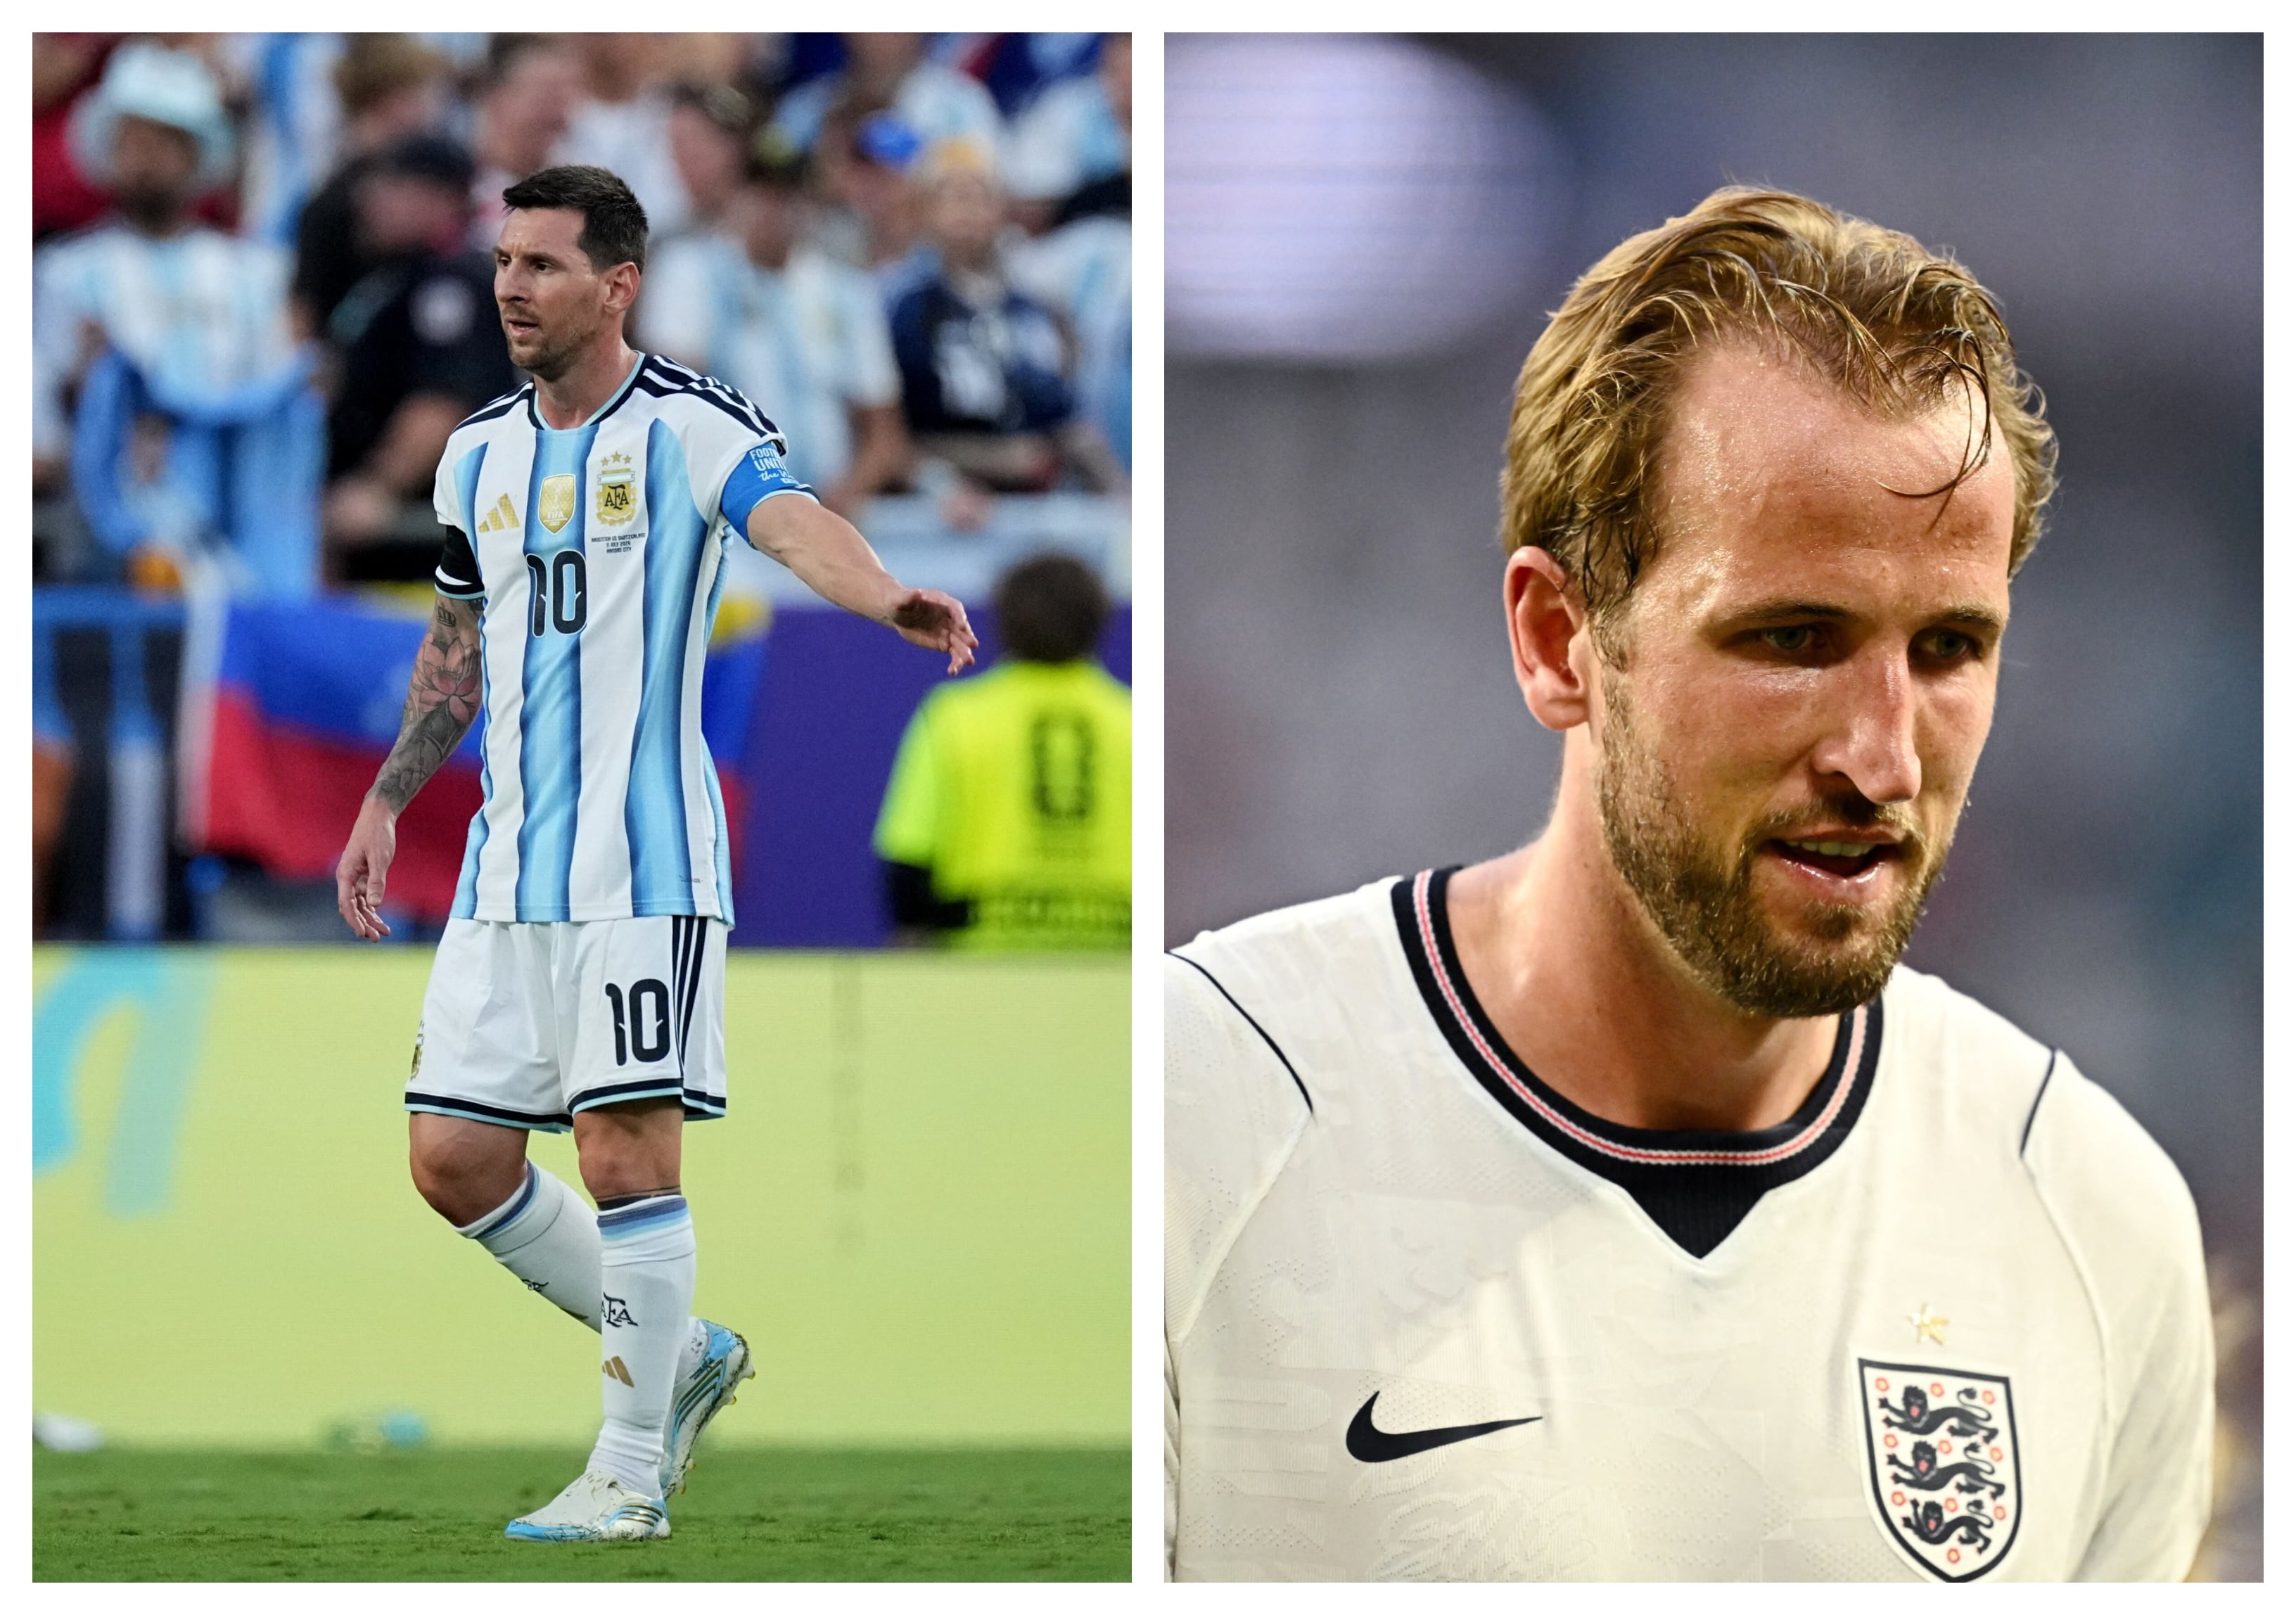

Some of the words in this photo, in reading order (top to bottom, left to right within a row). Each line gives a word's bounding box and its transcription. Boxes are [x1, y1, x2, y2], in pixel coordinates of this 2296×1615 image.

[547, 511, 563, 519] FIFA
[604, 484, 630, 510] AFA
[525, 550, 587, 637] 10
[605, 978, 670, 1066] 10
